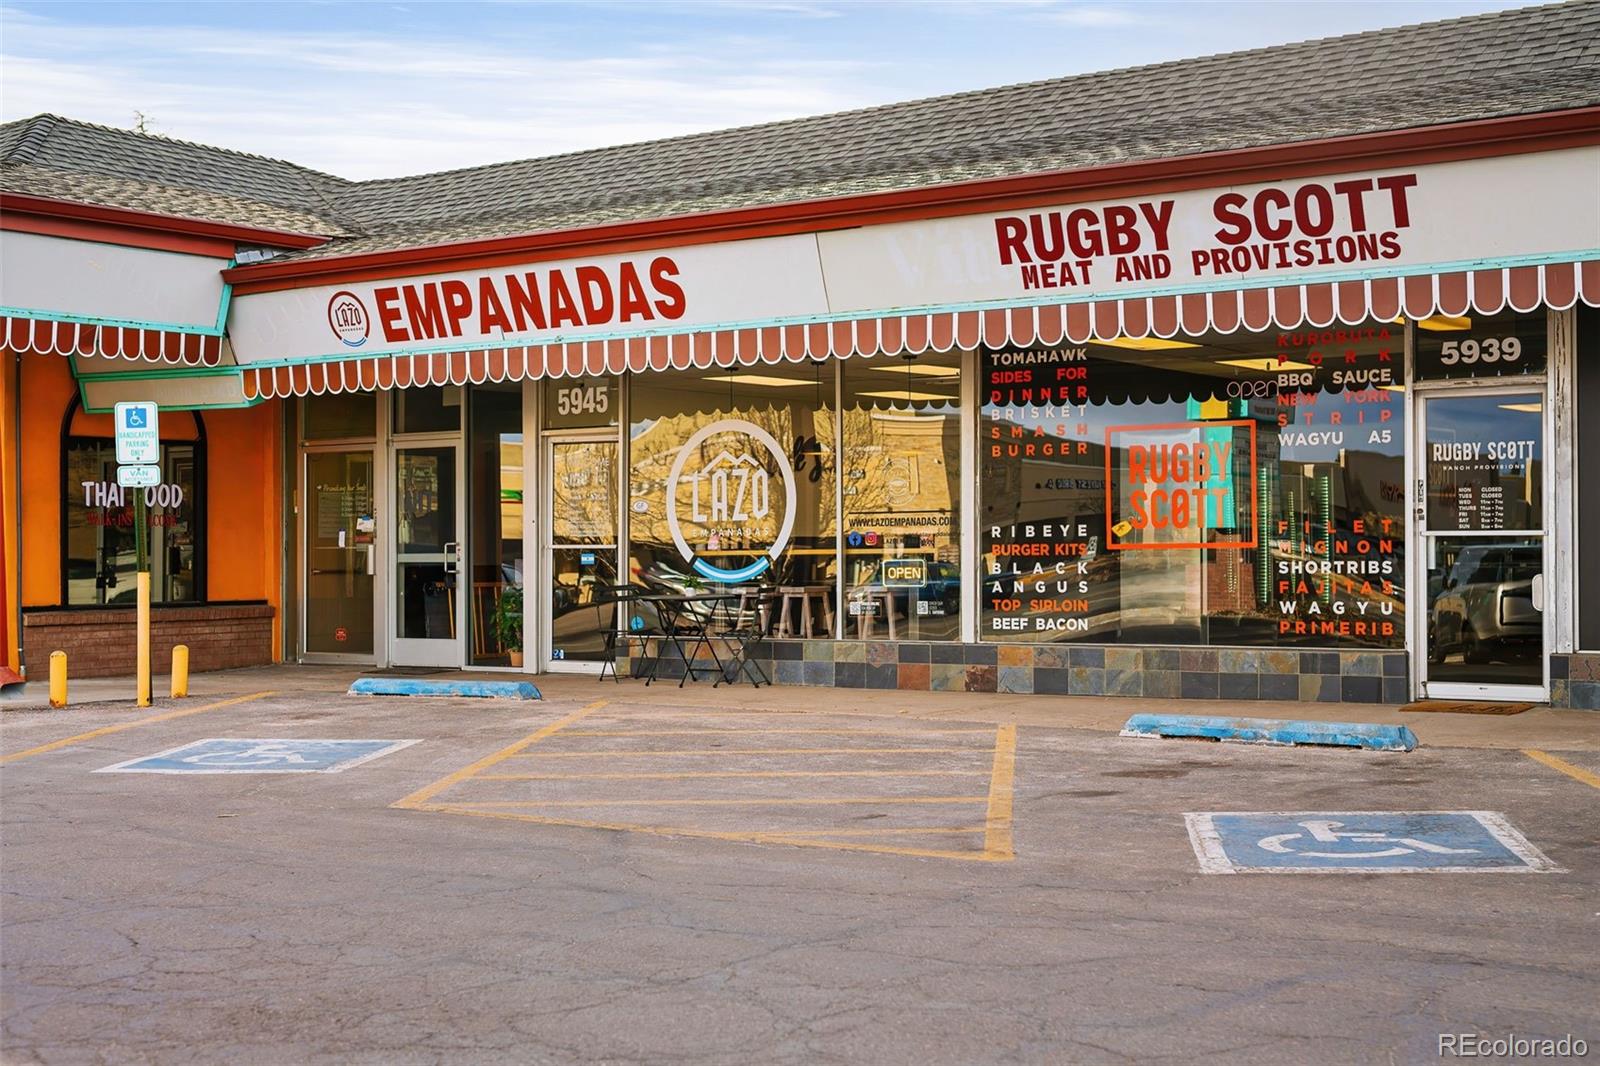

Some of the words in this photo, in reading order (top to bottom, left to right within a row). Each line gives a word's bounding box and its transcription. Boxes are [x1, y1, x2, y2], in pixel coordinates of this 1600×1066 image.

[995, 200, 1174, 265] RUGBY
[1213, 173, 1417, 245] SCOTT
[1021, 260, 1093, 290] MEAT
[1115, 254, 1171, 282] AND
[1192, 231, 1401, 276] PROVISIONS
[374, 256, 686, 343] EMPANADAS
[335, 306, 362, 327] LAZO
[1277, 328, 1391, 347] KUROBUTA
[991, 348, 1087, 366] TOMAHAWK
[1278, 348, 1391, 367] PORK
[1441, 337, 1521, 365] 5939
[991, 371, 1032, 384] SIDES
[1056, 368, 1087, 382] FOR
[1278, 373, 1313, 387] BBQ
[1332, 368, 1391, 384] SAUCE
[991, 386, 1087, 402] DINNER
[1226, 380, 1279, 400] open
[558, 386, 608, 415] 5945
[1278, 392, 1317, 407] NEW
[1343, 390, 1391, 404] YORK
[991, 405, 1087, 421] BRISKET
[1278, 410, 1392, 427] STRIP
[991, 424, 1087, 439] SMASH
[1278, 431, 1344, 446] WAGYU
[1368, 430, 1392, 444] A5
[126, 440, 149, 448] PARKING
[992, 442, 1087, 457] BURGER
[1433, 442, 1481, 461] RUGBY
[131, 449, 144, 457] ONLY
[1129, 442, 1231, 484] RUGBY
[82, 481, 125, 508] THAI
[692, 466, 768, 522] LAZO
[848, 517, 957, 527] WWW.LAZOEMPANADAS.COM
[1279, 520, 1393, 534] FILET
[692, 527, 769, 537] EMPANADAS
[992, 524, 1087, 538] RIBEYE
[992, 543, 1049, 556] BURGER
[1055, 543, 1088, 556] KITS
[1279, 540, 1393, 554] MIGNON
[888, 566, 921, 580] OPEN
[992, 562, 1088, 575] BLACK
[1278, 561, 1393, 574] SHORTRIBS
[992, 581, 1088, 593] ANGUS
[1279, 580, 1393, 595] FAJITAS
[992, 599, 1020, 612] TOP
[1030, 599, 1088, 612] SIRLOIN
[1279, 601, 1393, 614] WAGYU
[993, 618, 1028, 631] BEEF
[1035, 618, 1088, 631] BACON
[1279, 621, 1393, 636] PRIMERIB
